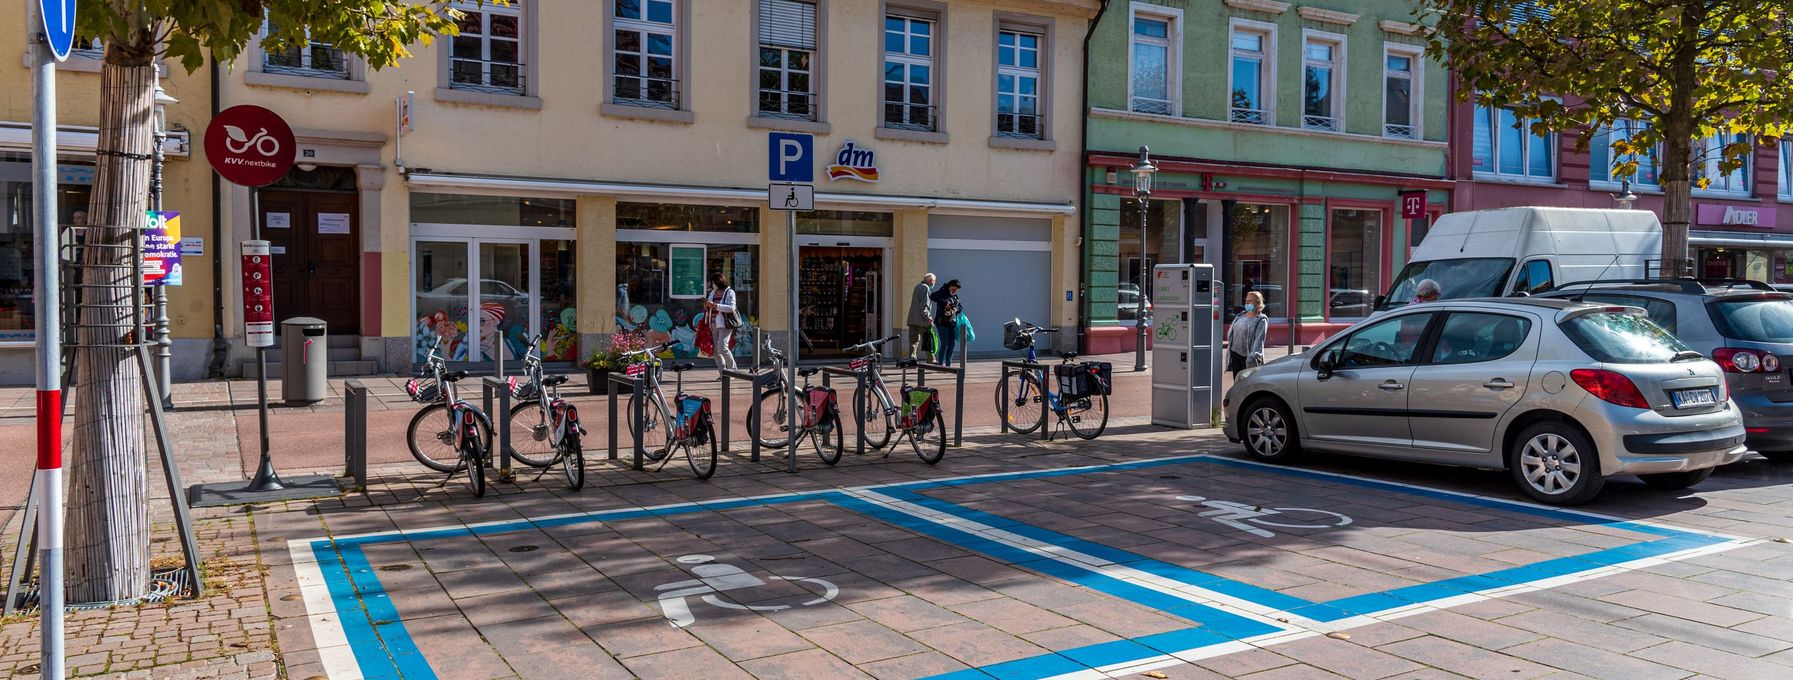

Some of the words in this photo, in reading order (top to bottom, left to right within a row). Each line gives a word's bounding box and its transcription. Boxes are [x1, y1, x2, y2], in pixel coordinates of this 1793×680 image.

[780, 139, 803, 175] P
[838, 143, 874, 167] dm
[1407, 197, 1420, 215] T
[1723, 206, 1758, 225] ADLER
